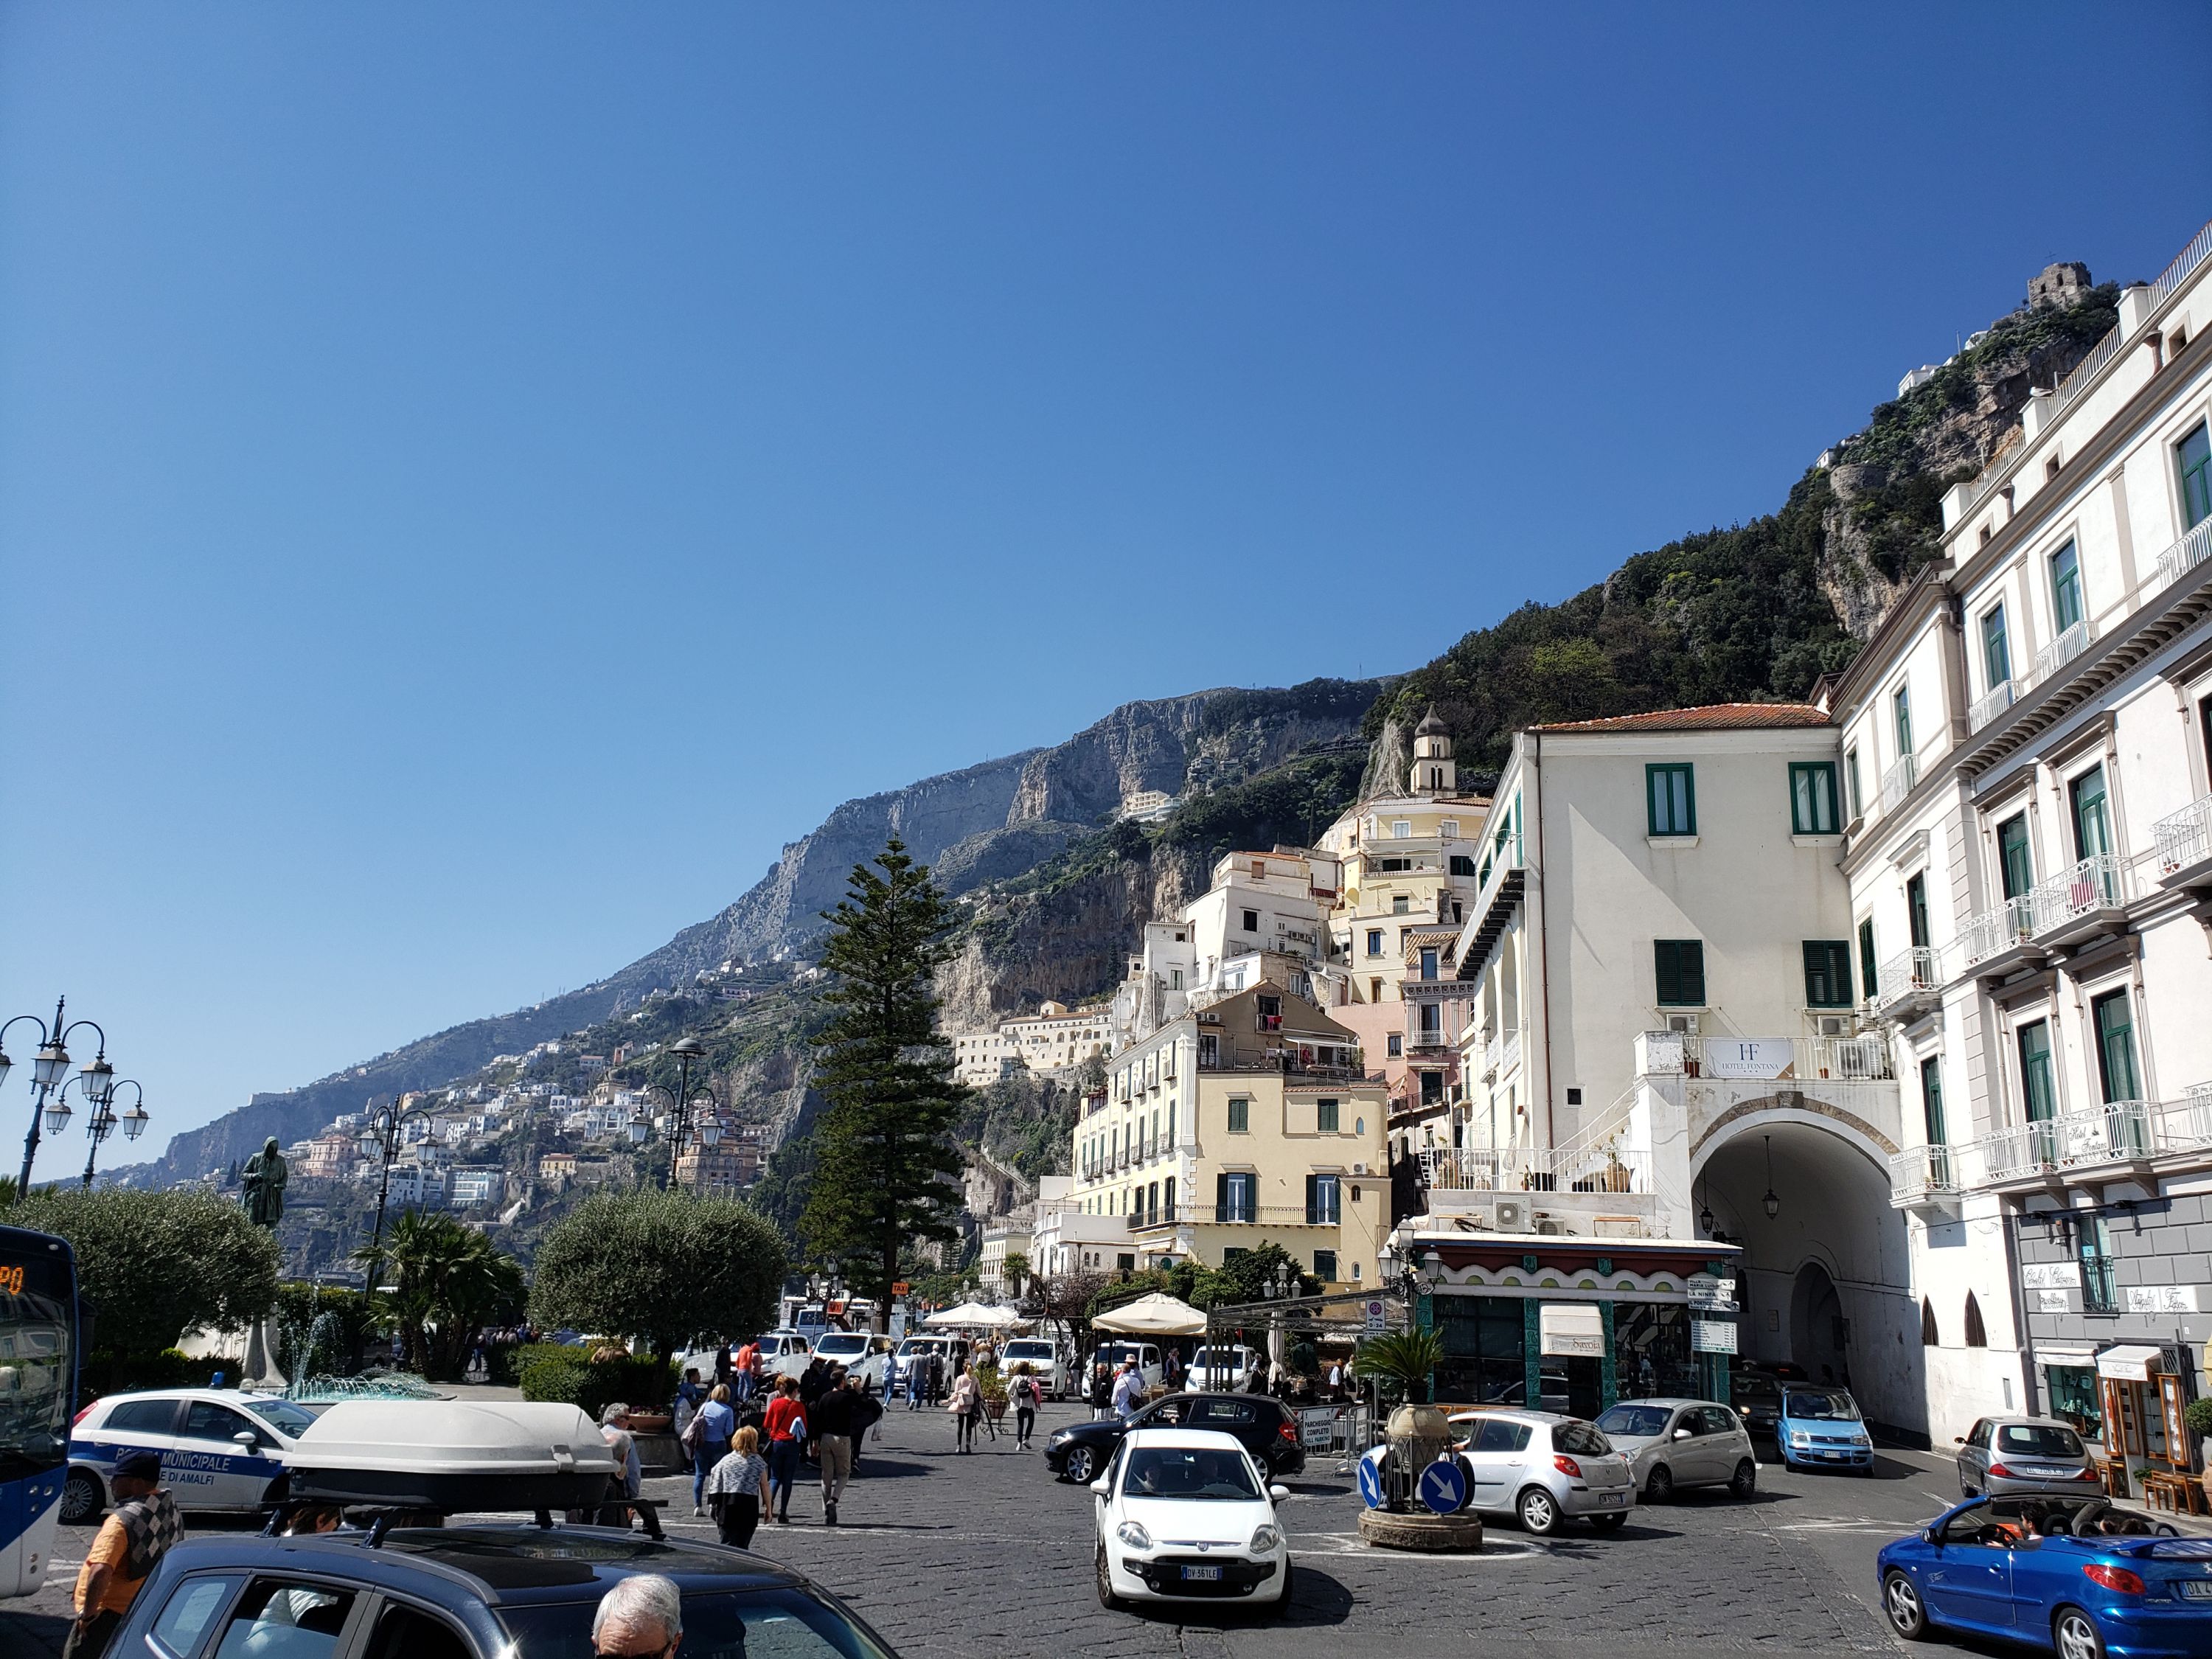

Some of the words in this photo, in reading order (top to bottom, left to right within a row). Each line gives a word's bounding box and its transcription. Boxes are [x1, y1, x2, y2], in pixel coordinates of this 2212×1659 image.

[830, 1303, 842, 1312] TAXI
[1573, 1338, 1601, 1349] Savoia
[1304, 1419, 1331, 1428] PARCHEGGIO
[1307, 1427, 1329, 1436] COMPLETO
[161, 1453, 231, 1471] MUNICIPALE
[168, 1472, 178, 1482] DI
[178, 1473, 215, 1485] AMALFI
[1188, 1569, 1195, 1578] DV
[1197, 1569, 1217, 1578] 361LE
[2186, 1582, 2202, 1595] DA
